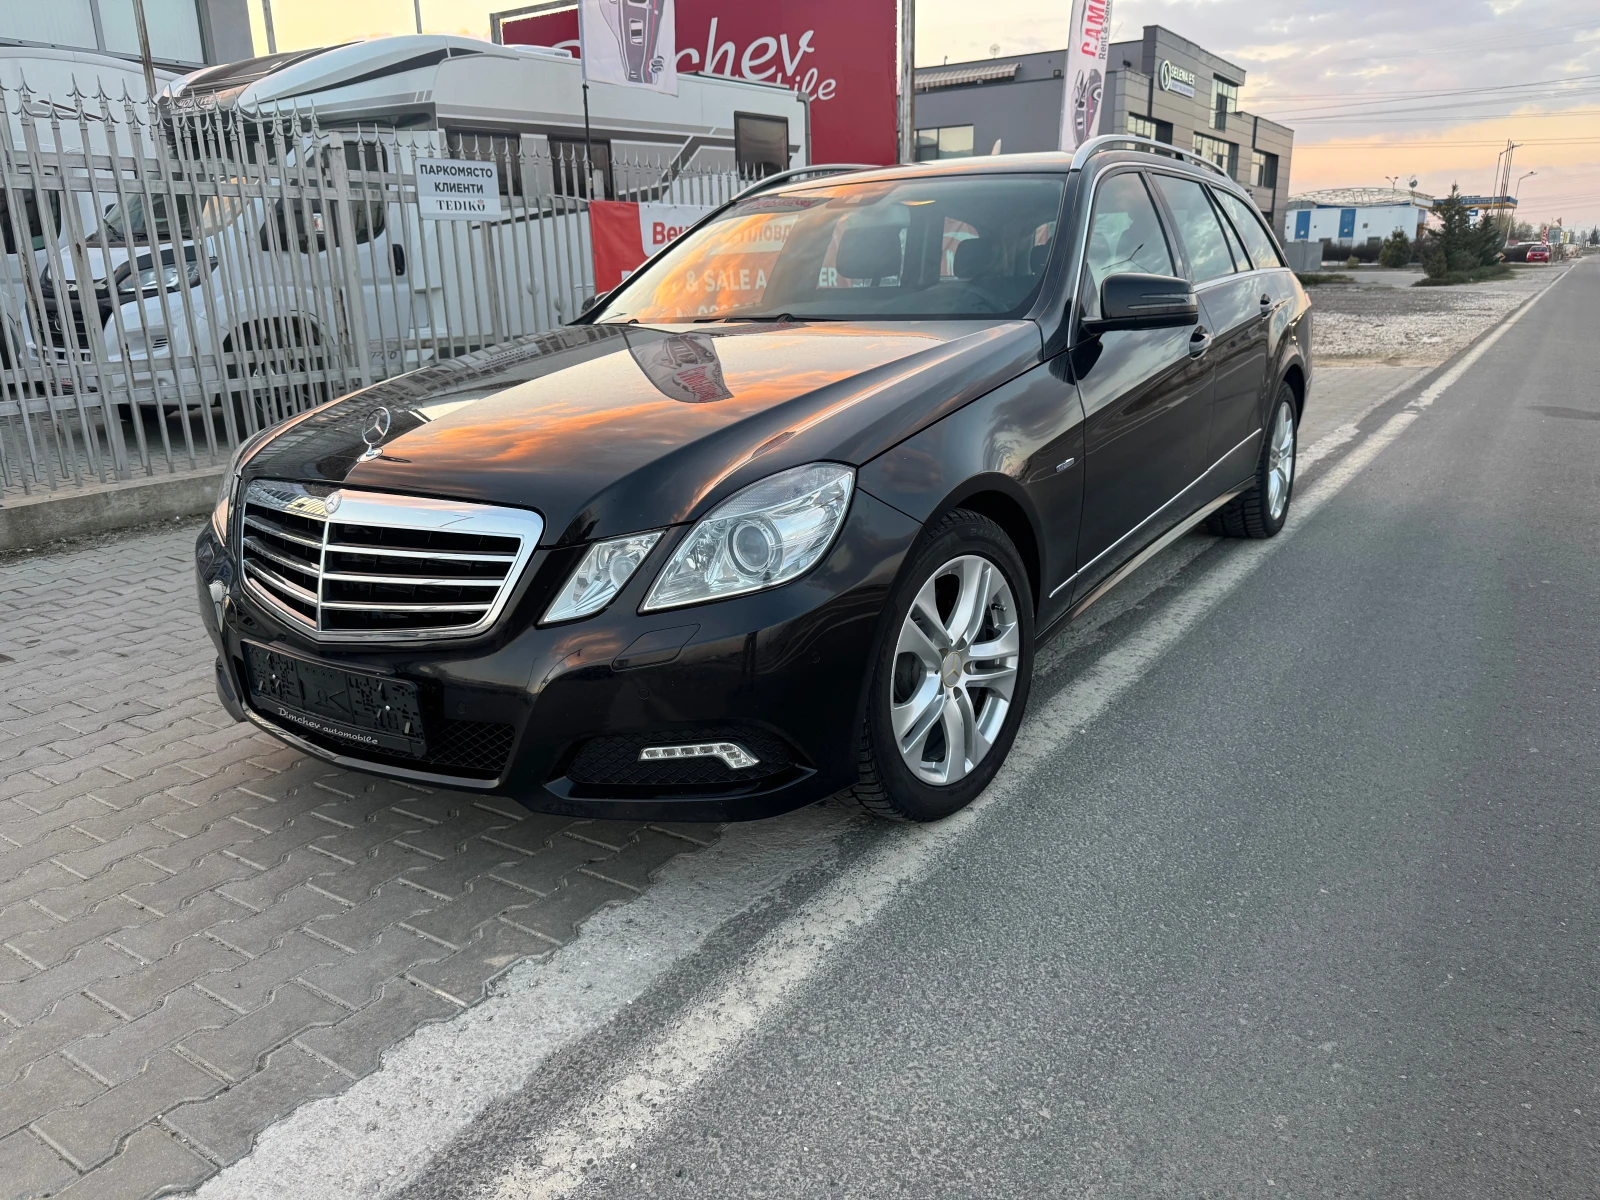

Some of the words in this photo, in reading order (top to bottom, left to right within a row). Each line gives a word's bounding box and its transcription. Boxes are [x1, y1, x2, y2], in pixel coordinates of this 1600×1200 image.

[1101, 26, 1108, 34] &
[1098, 36, 1107, 60] Rent
[420, 164, 493, 178] ПАРКОМЯСТО
[434, 182, 484, 194] КЛИЕНТИ
[686, 270, 698, 292] &
[704, 269, 750, 292] SALE
[278, 707, 320, 729] Dimchev
[322, 726, 378, 745] automobile
